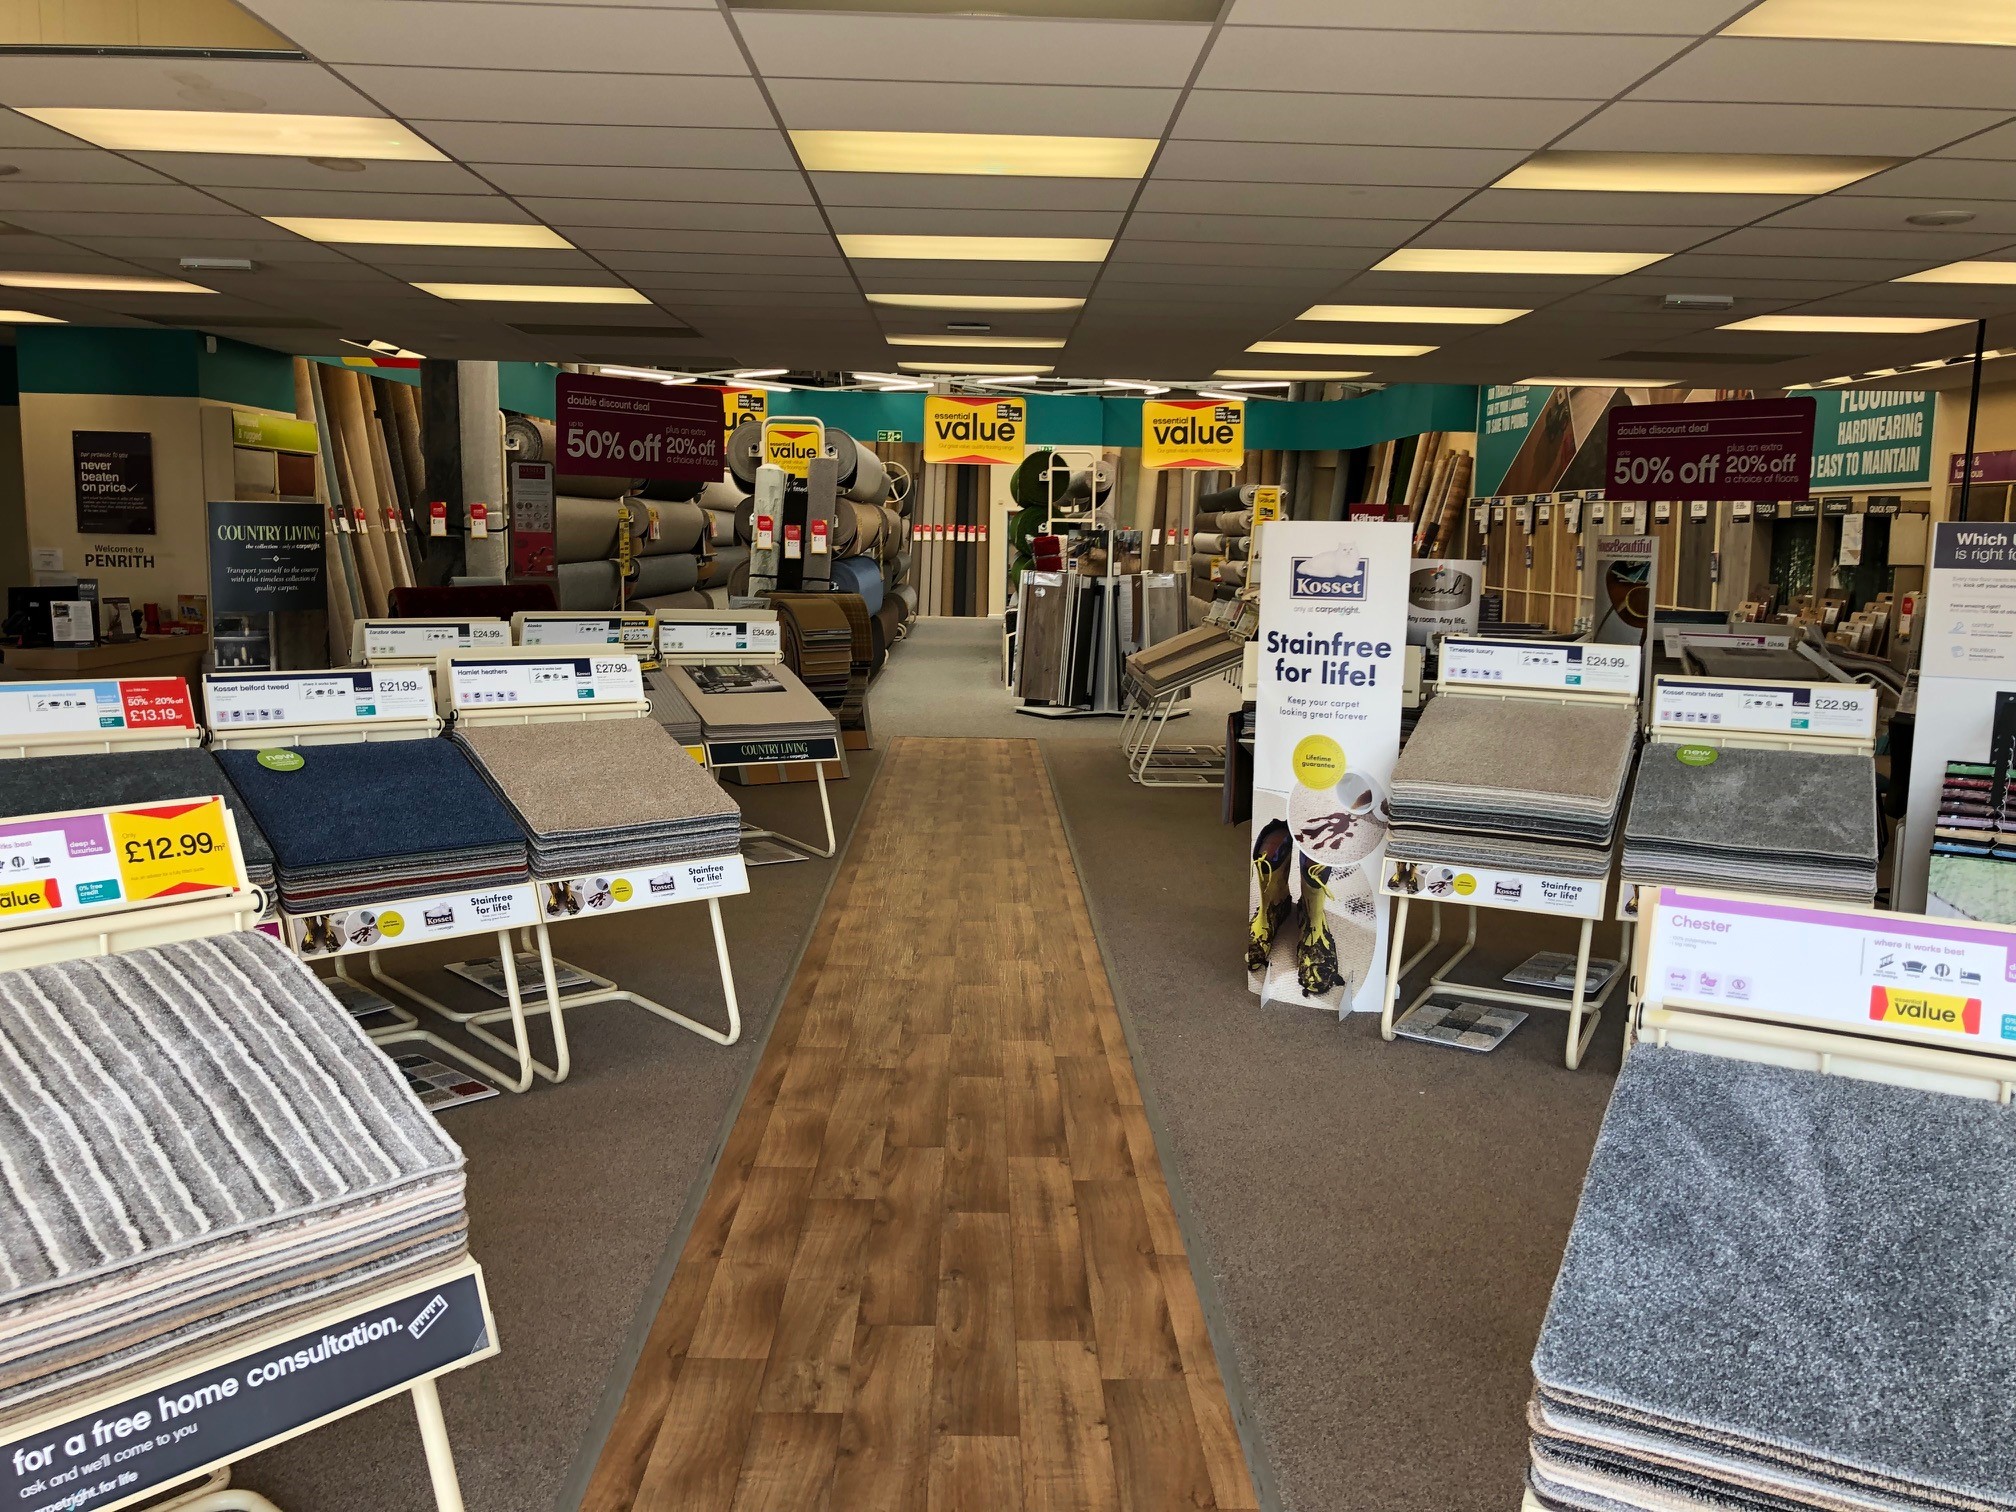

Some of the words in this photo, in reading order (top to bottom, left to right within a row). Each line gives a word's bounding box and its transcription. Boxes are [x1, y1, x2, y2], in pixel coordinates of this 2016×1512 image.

[567, 394, 597, 407] double
[599, 398, 631, 410] discount
[633, 402, 650, 411] deal
[1153, 417, 1189, 425] essential
[666, 426, 679, 435] plus
[690, 428, 706, 436] extra
[935, 413, 1015, 442] value
[1153, 416, 1234, 445] value
[1618, 425, 1647, 436] double
[1649, 424, 1686, 435] discount
[1688, 423, 1709, 433] deal
[1838, 411, 1923, 446] HARDWEARING
[567, 428, 625, 460] 50%
[629, 433, 662, 462] off
[666, 437, 697, 455] 20%
[699, 440, 716, 457] off
[770, 442, 817, 459] value
[1726, 443, 1745, 454] plus
[1747, 444, 1758, 452] an
[1760, 443, 1783, 452] extra
[81, 461, 112, 470] never
[673, 456, 695, 465] choice
[703, 458, 719, 467] floors
[1726, 455, 1767, 474] 20%
[1770, 453, 1796, 473] off
[1817, 452, 1844, 478] EASY
[1846, 452, 1859, 476] TO
[1861, 446, 1921, 475] MAINTAIN
[1614, 456, 1674, 485] 50%
[1679, 454, 1720, 484] off
[81, 472, 119, 482] beaten
[1733, 474, 1762, 484] choice
[1775, 473, 1799, 483] floors
[82, 483, 96, 492] on
[98, 482, 126, 494] price
[217, 525, 281, 541] COUNTRY
[284, 525, 320, 541] LIVING
[1956, 532, 2008, 546] Which
[94, 544, 134, 553] Welcome
[135, 545, 144, 553] to
[85, 553, 155, 569] PENRITH
[1955, 547, 1967, 560] is
[1971, 547, 2003, 564] right
[226, 567, 257, 575] Transport
[258, 566, 282, 575] yourself
[300, 567, 319, 577] country
[260, 575, 284, 583] timeless
[254, 585, 276, 593] quality
[1295, 577, 1361, 595] Kosset
[1439, 616, 1454, 625] Any
[473, 630, 500, 638] £24.99
[1266, 630, 1392, 659] Stainfree
[1586, 656, 1625, 668] £24.99
[595, 663, 627, 674] £27.99
[1275, 657, 1312, 683] for
[1321, 660, 1376, 687] life!
[213, 685, 238, 693] Kosset
[240, 683, 266, 691] belford
[267, 682, 290, 690] tweed
[379, 681, 417, 692] £21.99
[1662, 689, 1684, 697] Kosset
[1707, 690, 1724, 698] twist
[127, 697, 148, 707] 50%
[155, 697, 175, 705] 20%
[1287, 695, 1307, 707] Keep
[1309, 699, 1328, 708] your
[1330, 699, 1360, 709] carpet
[1815, 699, 1858, 711] £22.99
[130, 708, 176, 722] £13.19
[1279, 707, 1307, 719] looking
[1309, 711, 1333, 720] great
[1335, 711, 1368, 721] forever
[741, 743, 779, 756] COUNTRY
[781, 742, 808, 754] LIVING
[1683, 748, 1711, 756] new
[265, 753, 294, 761] new
[1305, 754, 1332, 762] Lifetime
[1301, 760, 1335, 769] guarantee
[121, 832, 136, 840] Only
[69, 840, 89, 848] deep
[125, 832, 213, 864] £12.99
[71, 846, 104, 855] luxurious
[688, 864, 724, 876] Stainfree
[693, 875, 705, 883] for
[706, 873, 722, 882] life!
[1496, 888, 1520, 896] Kosset
[1541, 880, 1583, 892] Stainfree
[0, 890, 40, 908] alue
[470, 893, 513, 906] Stainfree
[1543, 889, 1558, 899] for
[1559, 891, 1578, 901] life!
[475, 903, 490, 914] for
[492, 902, 511, 912] life!
[426, 914, 453, 925] Kosset
[1672, 914, 1732, 933] Chester
[1874, 939, 1902, 949] where
[1914, 944, 1941, 953] works
[1944, 947, 1965, 956] best
[1894, 997, 1923, 1005] essential
[1895, 1000, 1956, 1023] value
[13, 1443, 55, 1476] for
[64, 1431, 87, 1458] a
[92, 1408, 152, 1447] free
[158, 1374, 240, 1422] home
[246, 1313, 404, 1387] consultation.
[19, 1478, 48, 1499] ask
[50, 1465, 79, 1488] and
[80, 1453, 111, 1477] we'll
[114, 1440, 154, 1463] come
[156, 1431, 170, 1448] to
[173, 1422, 199, 1445] you
[118, 1470, 139, 1487] life
